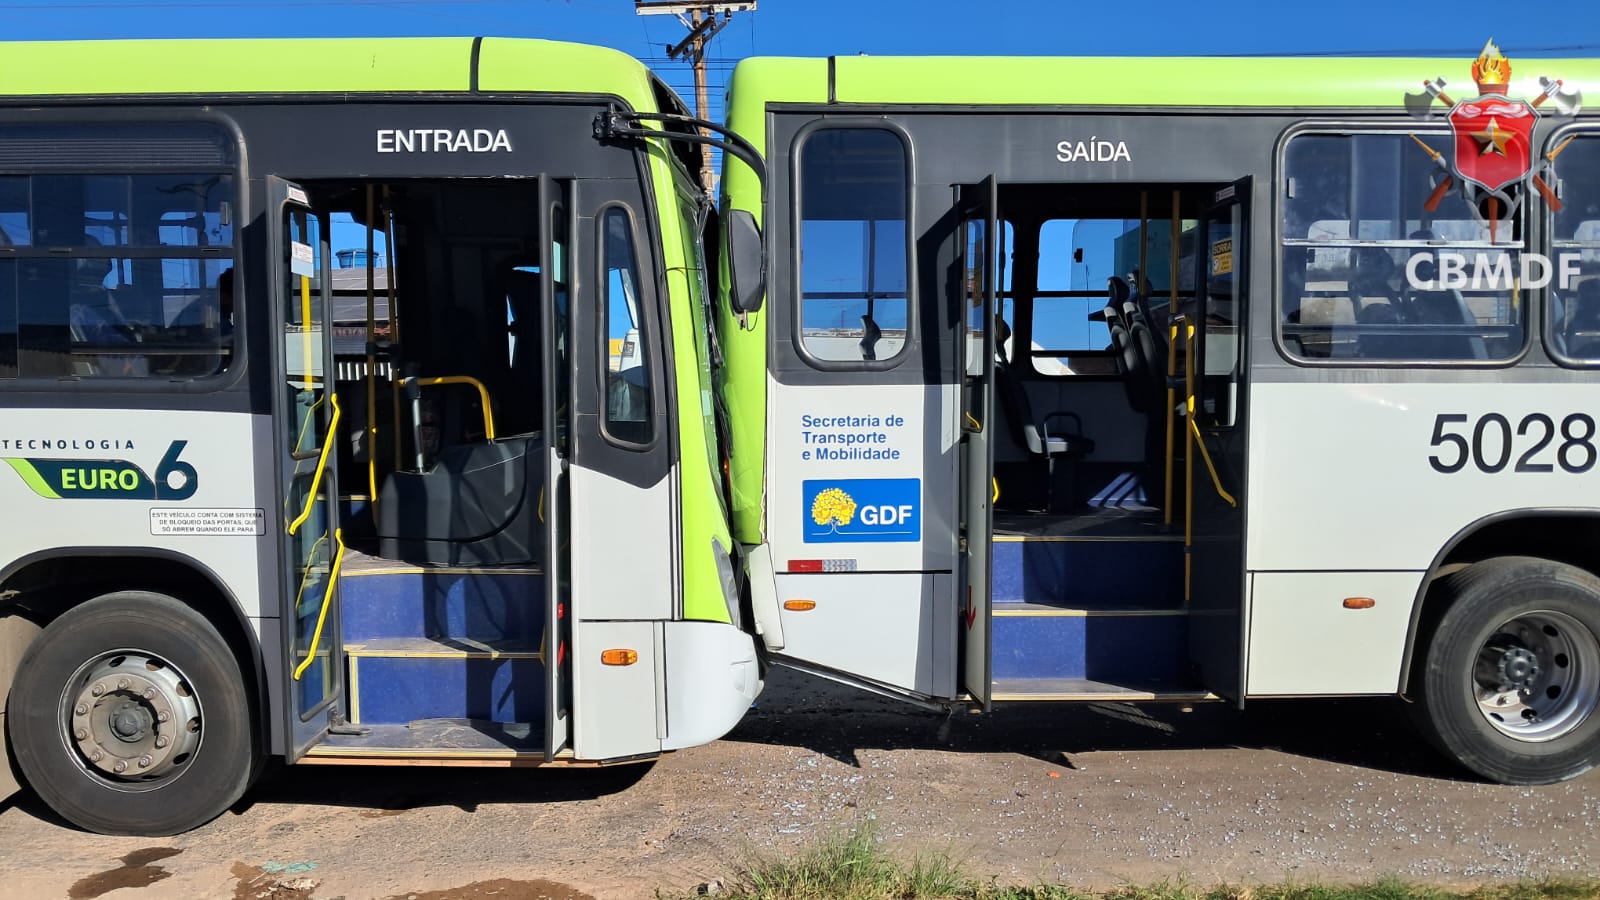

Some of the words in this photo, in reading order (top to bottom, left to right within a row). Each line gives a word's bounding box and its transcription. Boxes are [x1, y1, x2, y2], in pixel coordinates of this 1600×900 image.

[377, 129, 513, 153] ENTRADA
[1056, 135, 1132, 162] SAÍDA
[802, 414, 880, 427] Secretaria
[885, 414, 904, 427] de
[2, 439, 135, 450] TECNOLOGIA
[802, 431, 887, 446] Transporte
[1428, 412, 1597, 474] 5028
[802, 450, 811, 460] e
[816, 447, 900, 460] Mobilidade
[61, 468, 140, 491] EURO
[154, 440, 198, 501] 6
[860, 505, 913, 525] GDF
